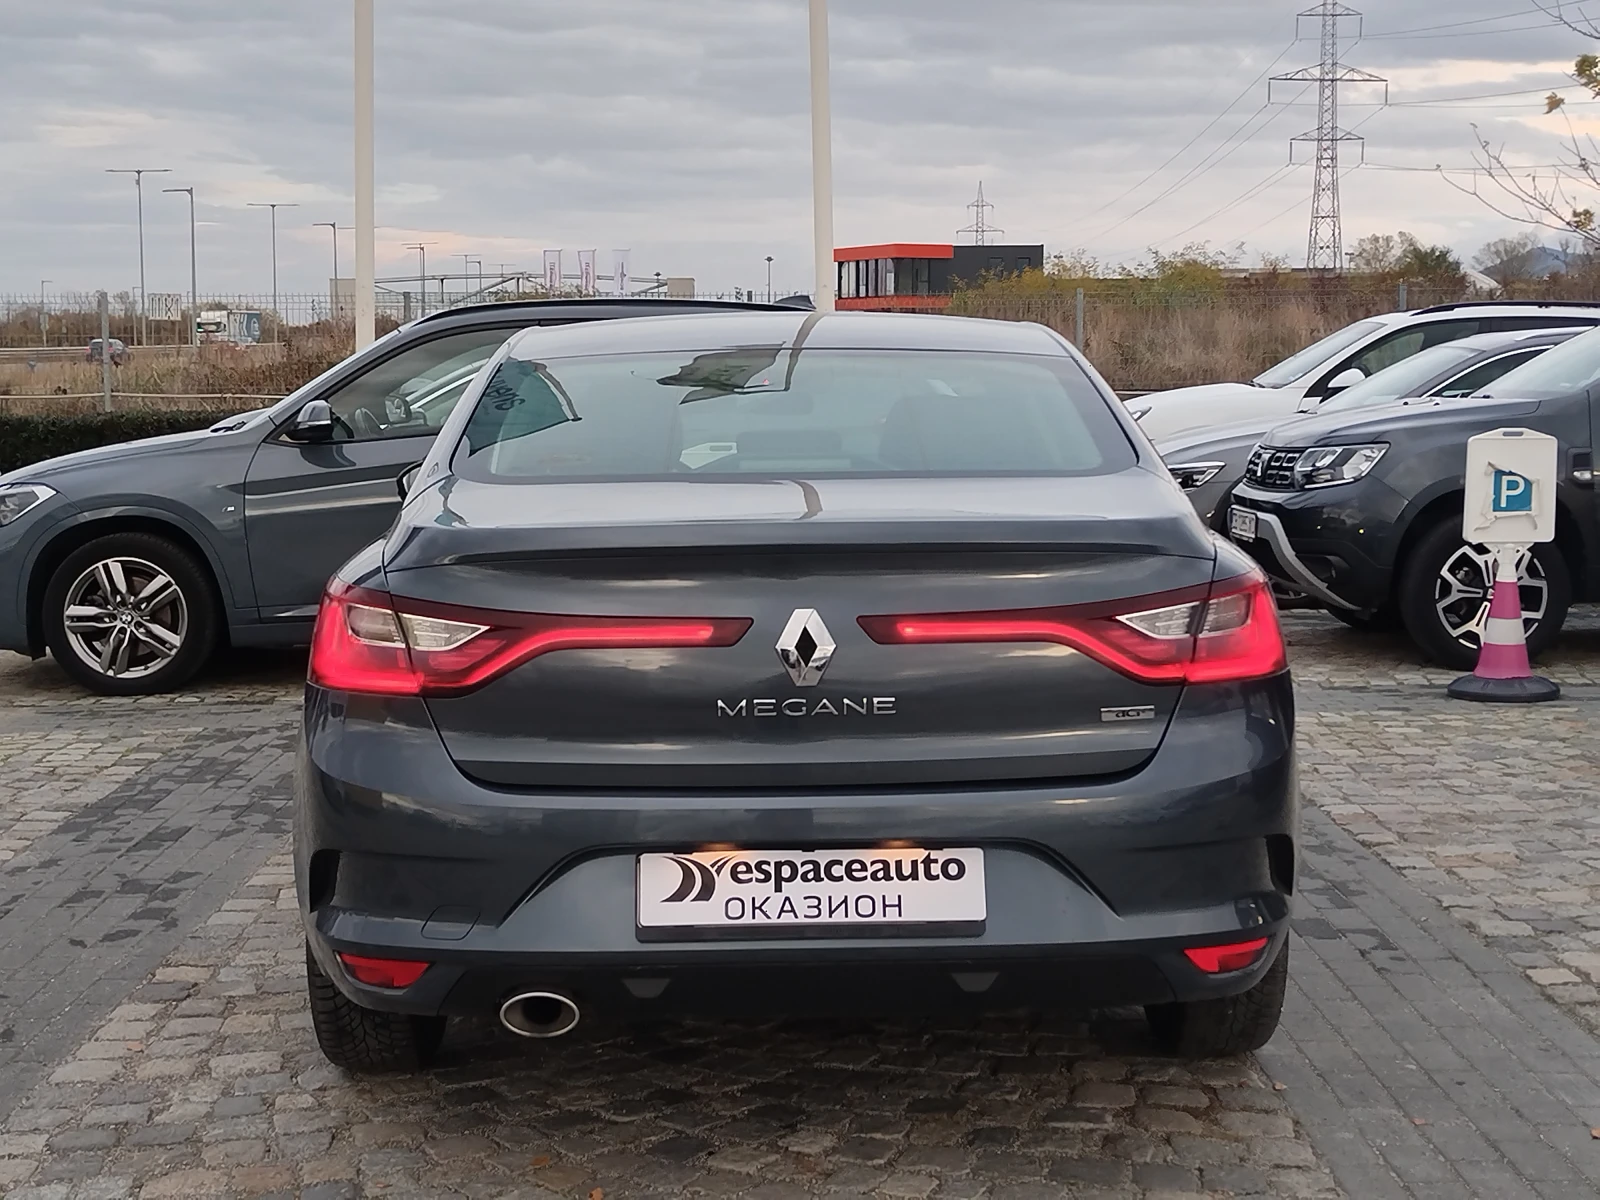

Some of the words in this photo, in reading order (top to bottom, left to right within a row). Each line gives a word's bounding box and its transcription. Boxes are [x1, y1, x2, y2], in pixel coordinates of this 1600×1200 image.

[1500, 475, 1525, 508] P
[716, 696, 897, 718] MEGANE
[730, 852, 967, 893] espaceauto
[724, 894, 904, 921] ОКАЗИОН
